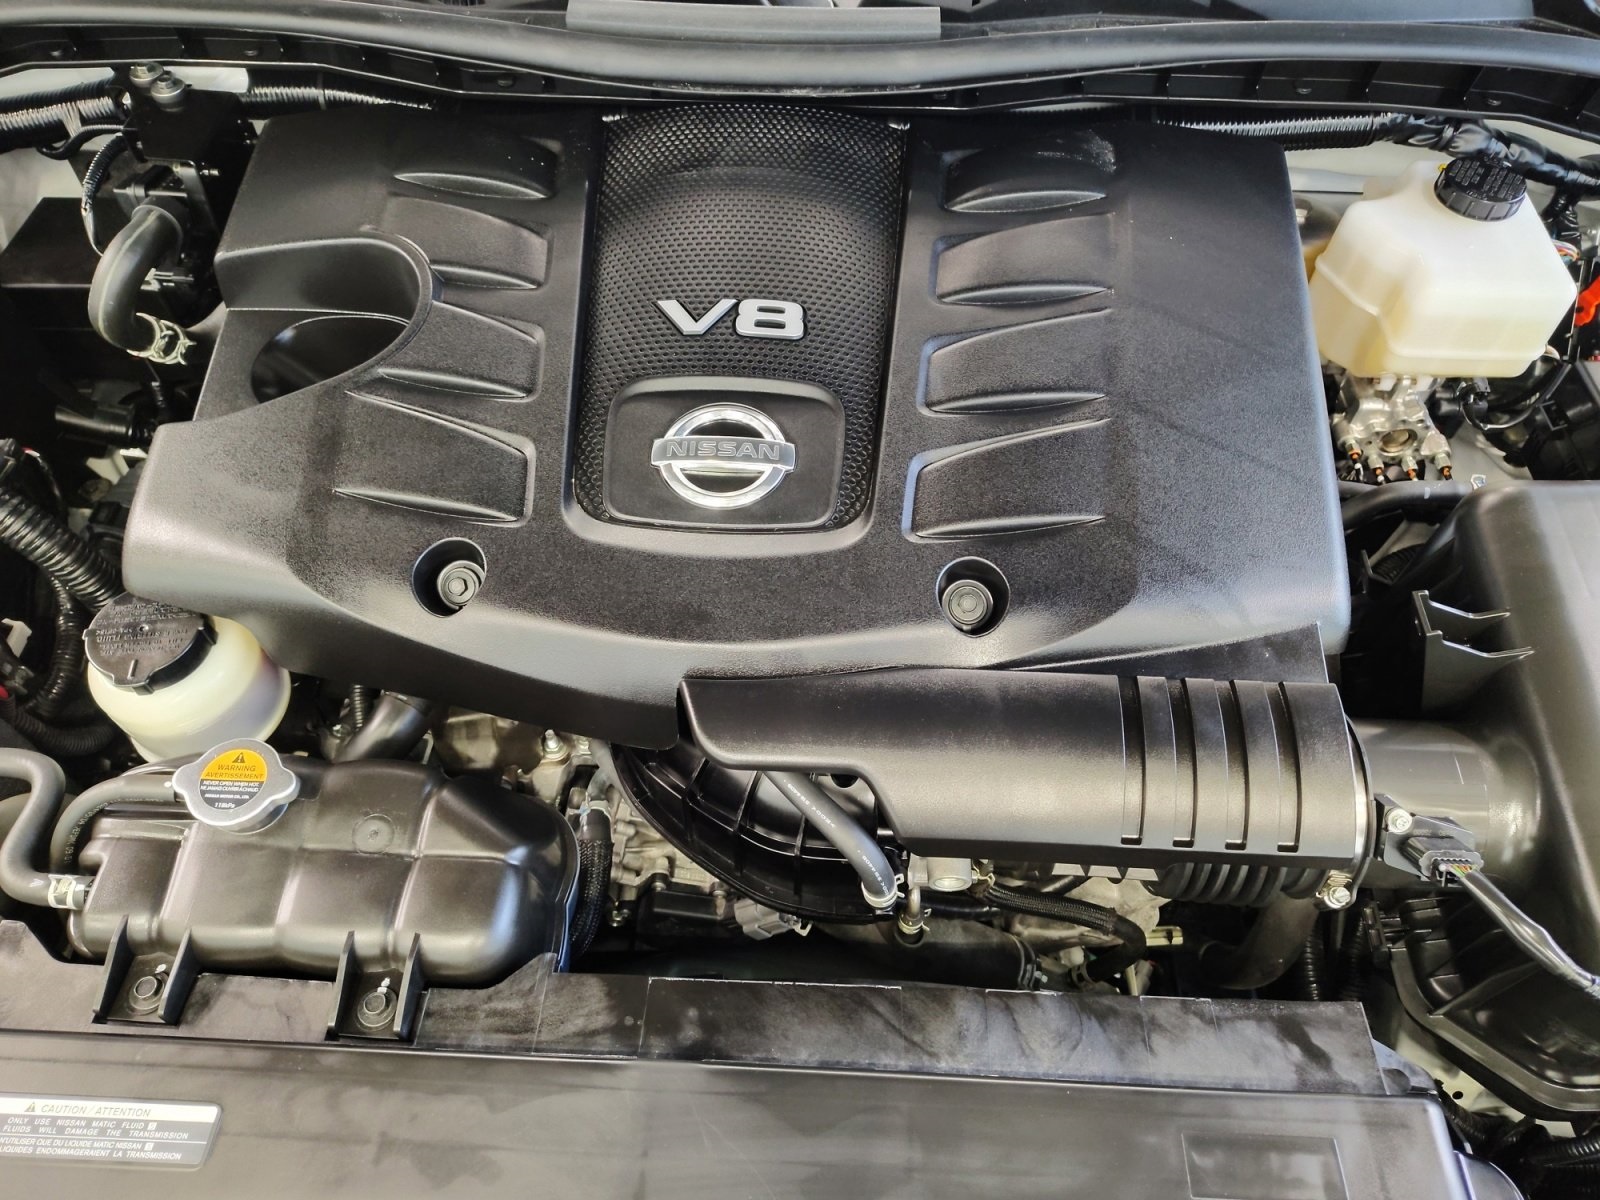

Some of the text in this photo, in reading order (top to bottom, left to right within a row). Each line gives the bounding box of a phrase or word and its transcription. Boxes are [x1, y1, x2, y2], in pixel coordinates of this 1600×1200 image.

[657, 298, 805, 340] V8
[666, 440, 780, 461] NISSAN
[218, 764, 256, 772] WARNING
[41, 1104, 87, 1114] CAUTION
[95, 1106, 152, 1118] ATTENTION
[7, 1117, 30, 1125] ONLY
[34, 1118, 52, 1126] USE
[56, 1119, 87, 1127] NISSAN
[92, 1120, 117, 1128] MATIC
[121, 1121, 145, 1129] FLUID
[64, 1128, 99, 1136] DAMAGE
[106, 1129, 122, 1137] THE
[129, 1130, 189, 1140] TRANSMISSION
[36, 1138, 52, 1146] QUE
[115, 1141, 142, 1150] NISSAN
[36, 1147, 111, 1157] ENDOMMAGERAIENT
[126, 1151, 182, 1160] TRANSMISSION
